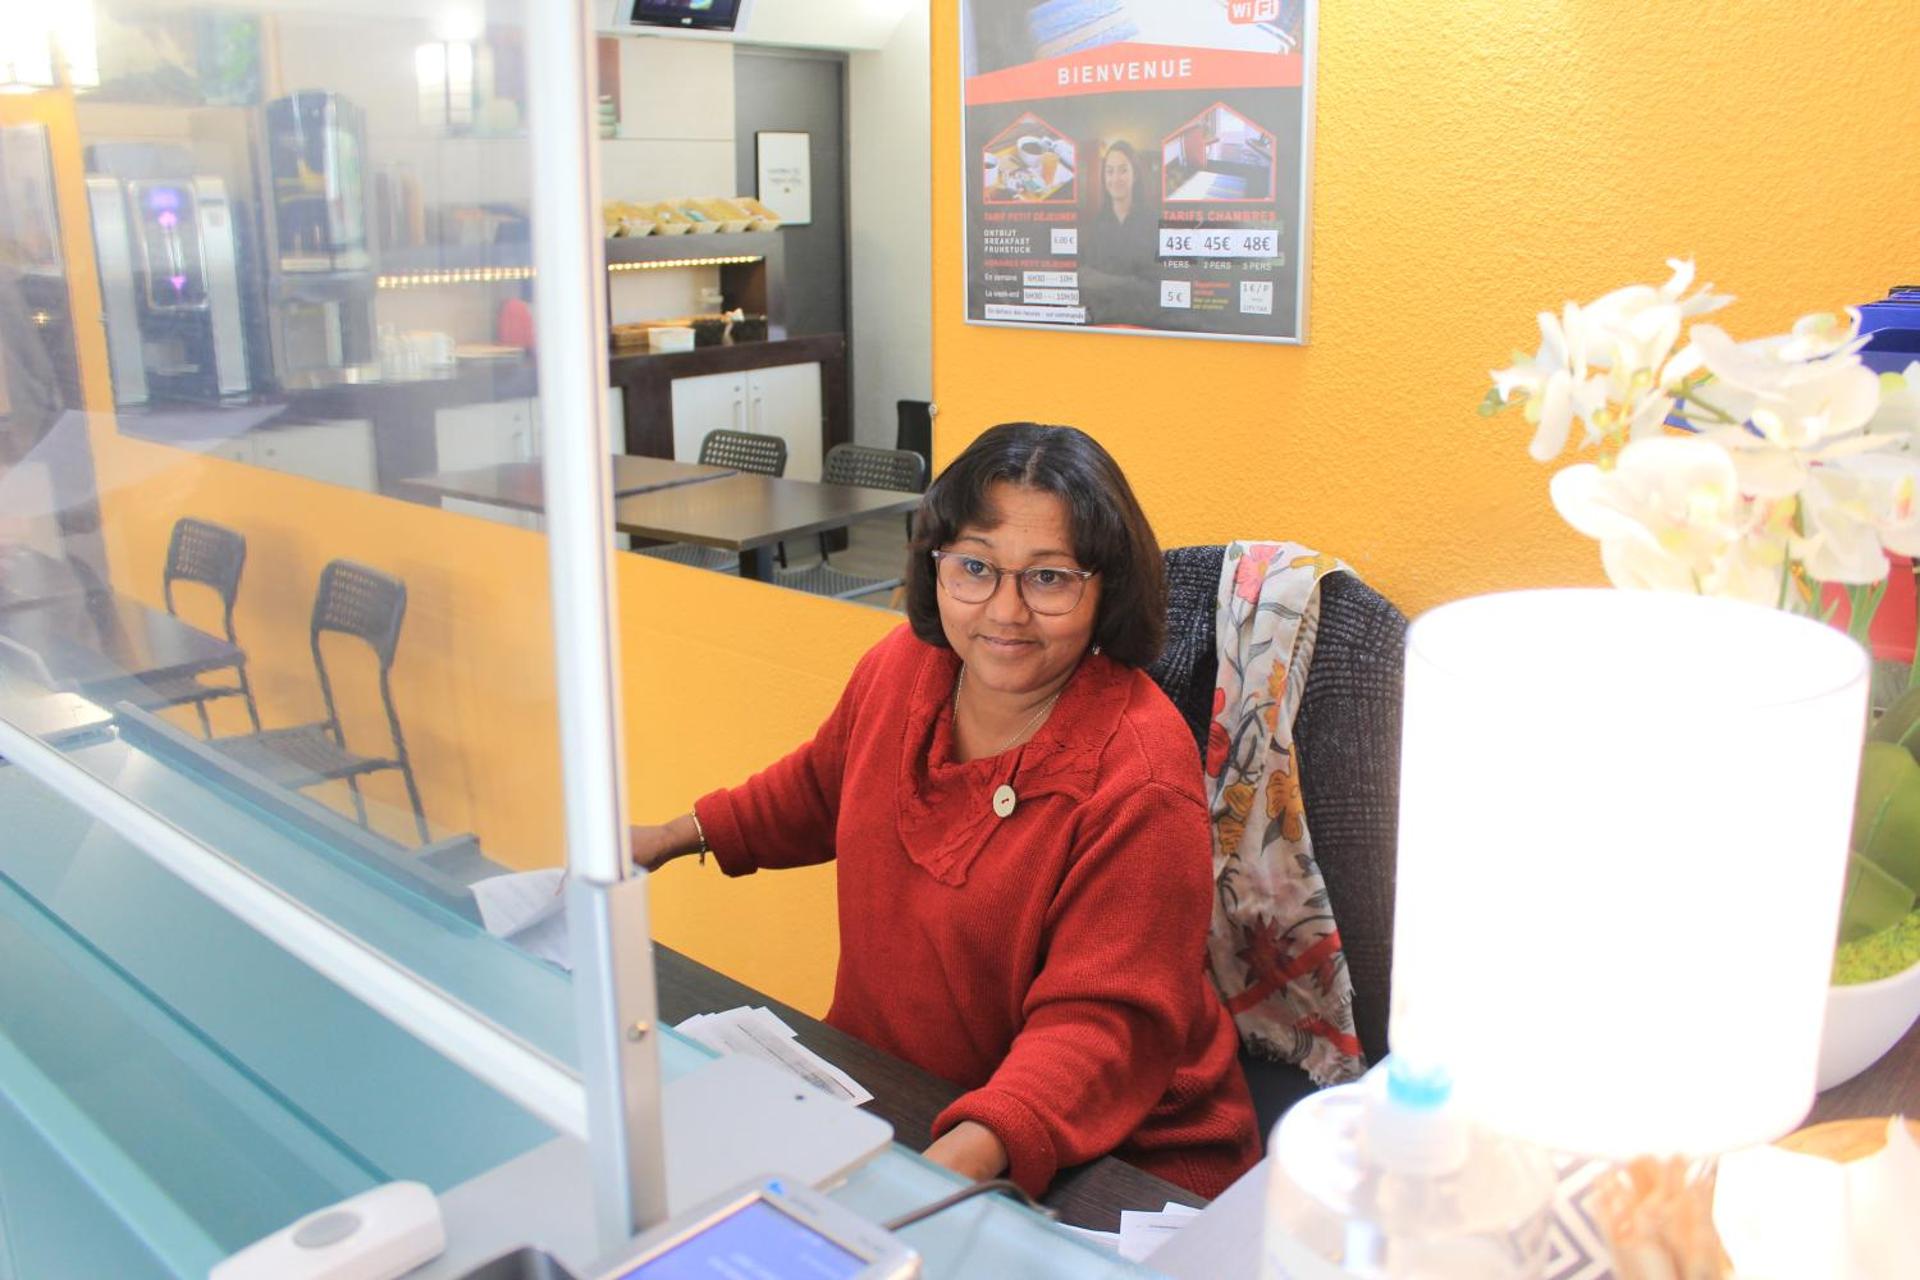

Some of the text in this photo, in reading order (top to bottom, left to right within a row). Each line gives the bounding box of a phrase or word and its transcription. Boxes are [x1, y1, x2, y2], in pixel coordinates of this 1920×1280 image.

[1058, 58, 1192, 85] BIENVENUE
[1163, 210, 1203, 221] TARIFS
[984, 237, 1030, 245] BREAKFAST
[1166, 236, 1270, 251] 43€ 45€ 48€
[1209, 261, 1232, 270] PERS
